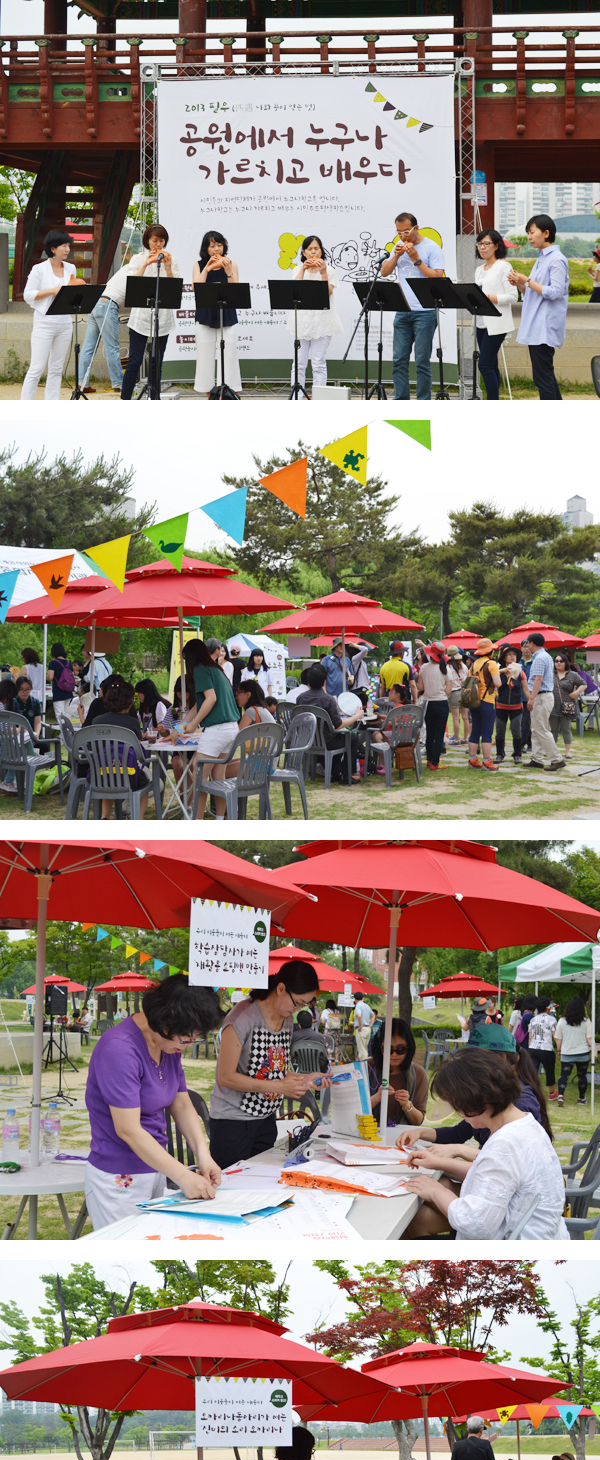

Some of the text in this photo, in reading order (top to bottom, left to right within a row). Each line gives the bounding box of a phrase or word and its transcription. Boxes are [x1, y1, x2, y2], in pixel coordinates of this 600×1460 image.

[185, 104, 205, 112] 2013
[179, 122, 388, 157] 공원에서 누구나
[198, 156, 411, 186] 가르치고 배우다
[257, 195, 282, 203] 공원에서
[235, 205, 252, 213] 누구나
[194, 941, 258, 960] 학습상담사가 여는
[200, 1411, 287, 1422] 오카리나동아리가 여는
[231, 1424, 247, 1433] 소리
